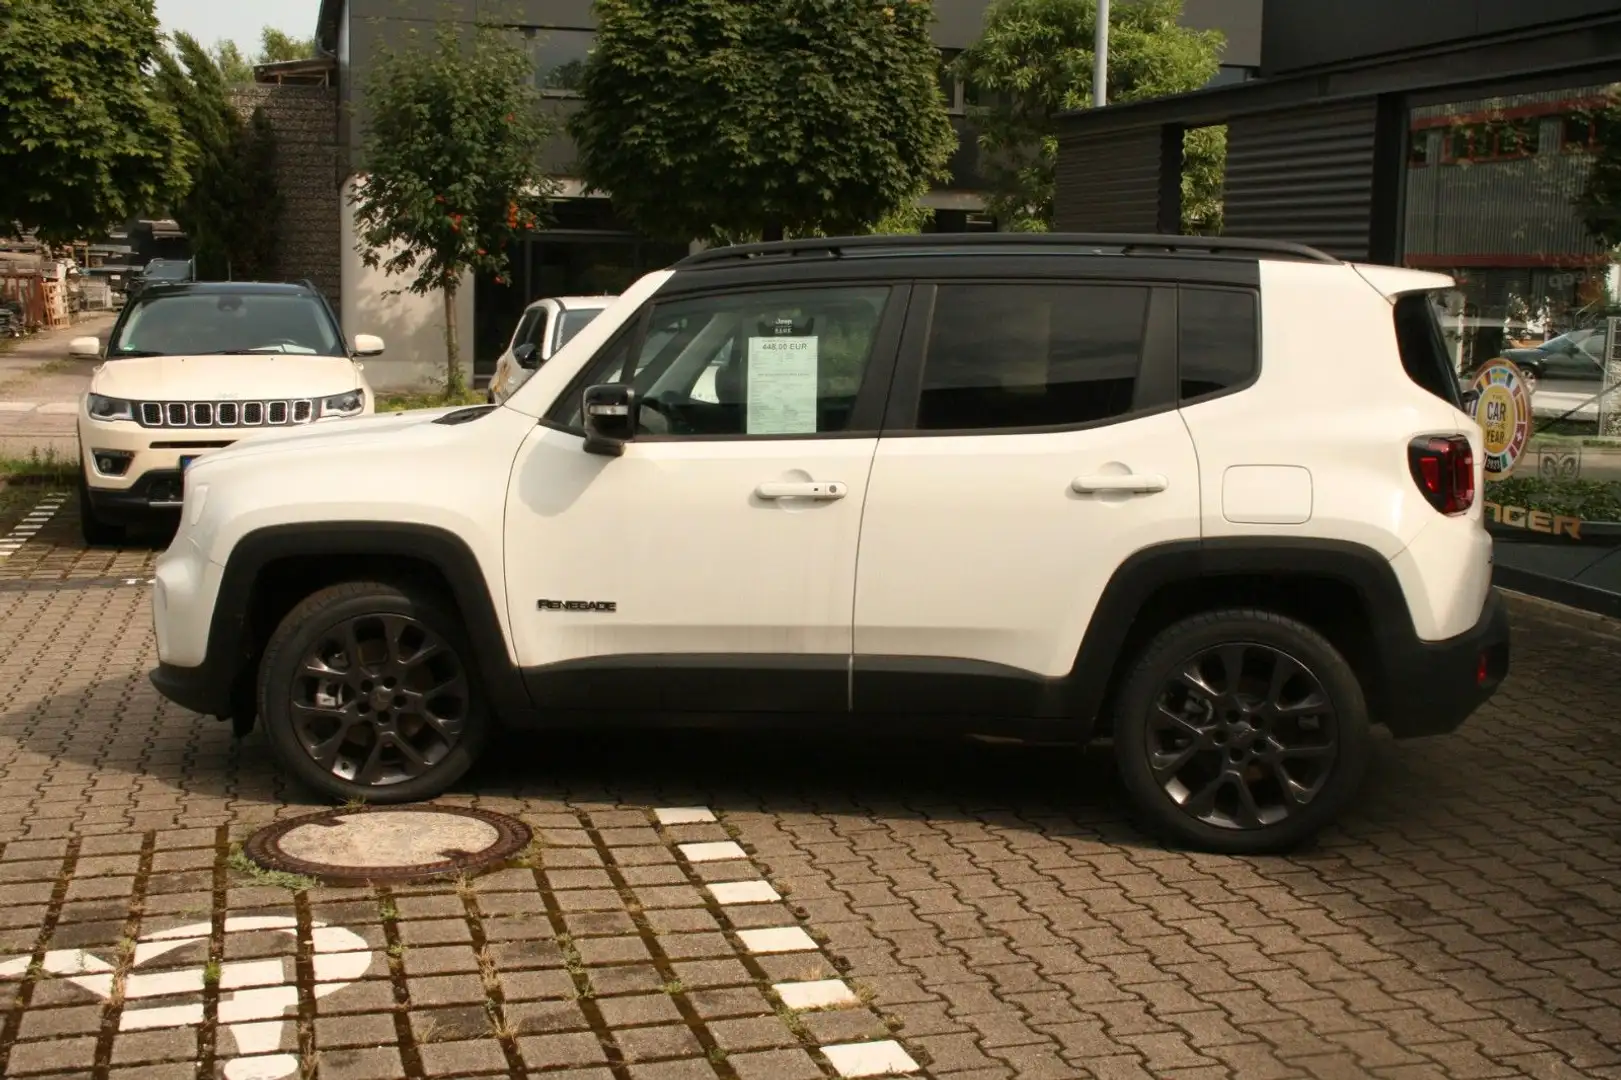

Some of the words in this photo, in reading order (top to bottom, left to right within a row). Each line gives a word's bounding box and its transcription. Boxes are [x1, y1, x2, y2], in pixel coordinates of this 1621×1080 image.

[1487, 402, 1506, 421] CAR
[1486, 430, 1505, 444] YEAR
[537, 599, 617, 612] RENEGADE
